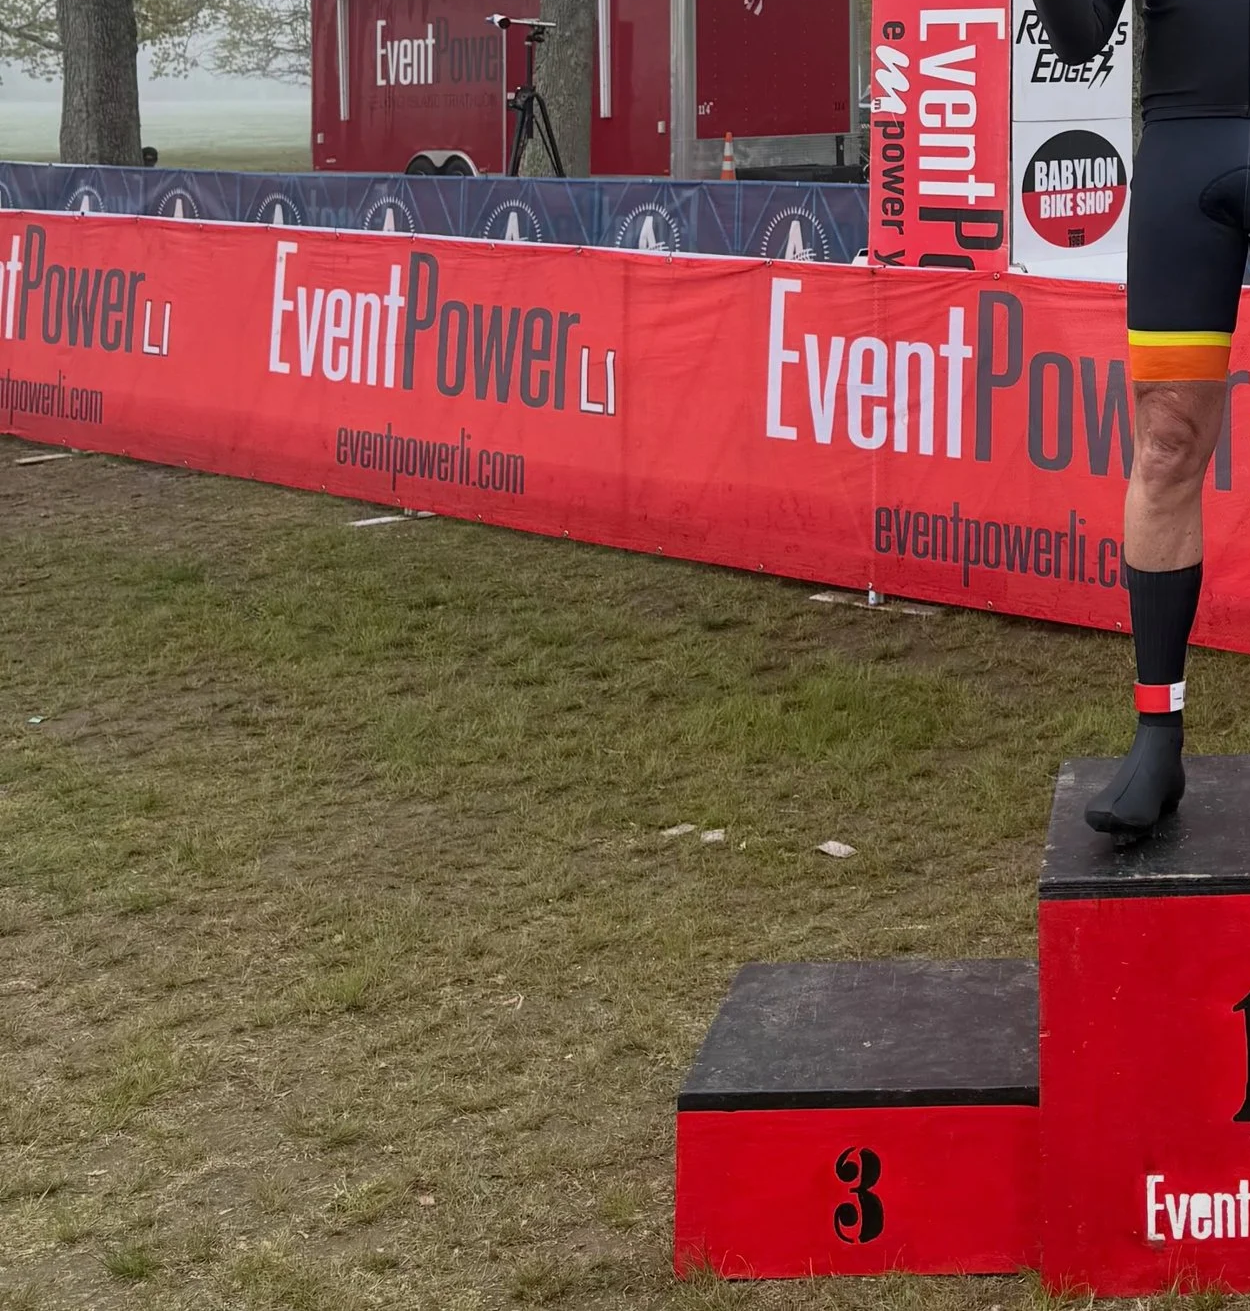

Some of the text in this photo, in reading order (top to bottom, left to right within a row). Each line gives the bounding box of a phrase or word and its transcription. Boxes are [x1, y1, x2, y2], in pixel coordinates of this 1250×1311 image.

[376, 16, 504, 86] EventPowe
[1034, 156, 1118, 192] BABYLON
[1040, 190, 1113, 219] BIKE SHOP
[336, 423, 525, 495] eventpowerli.com
[875, 502, 1129, 589] eventpowerli.c
[833, 1145, 885, 1245] 3
